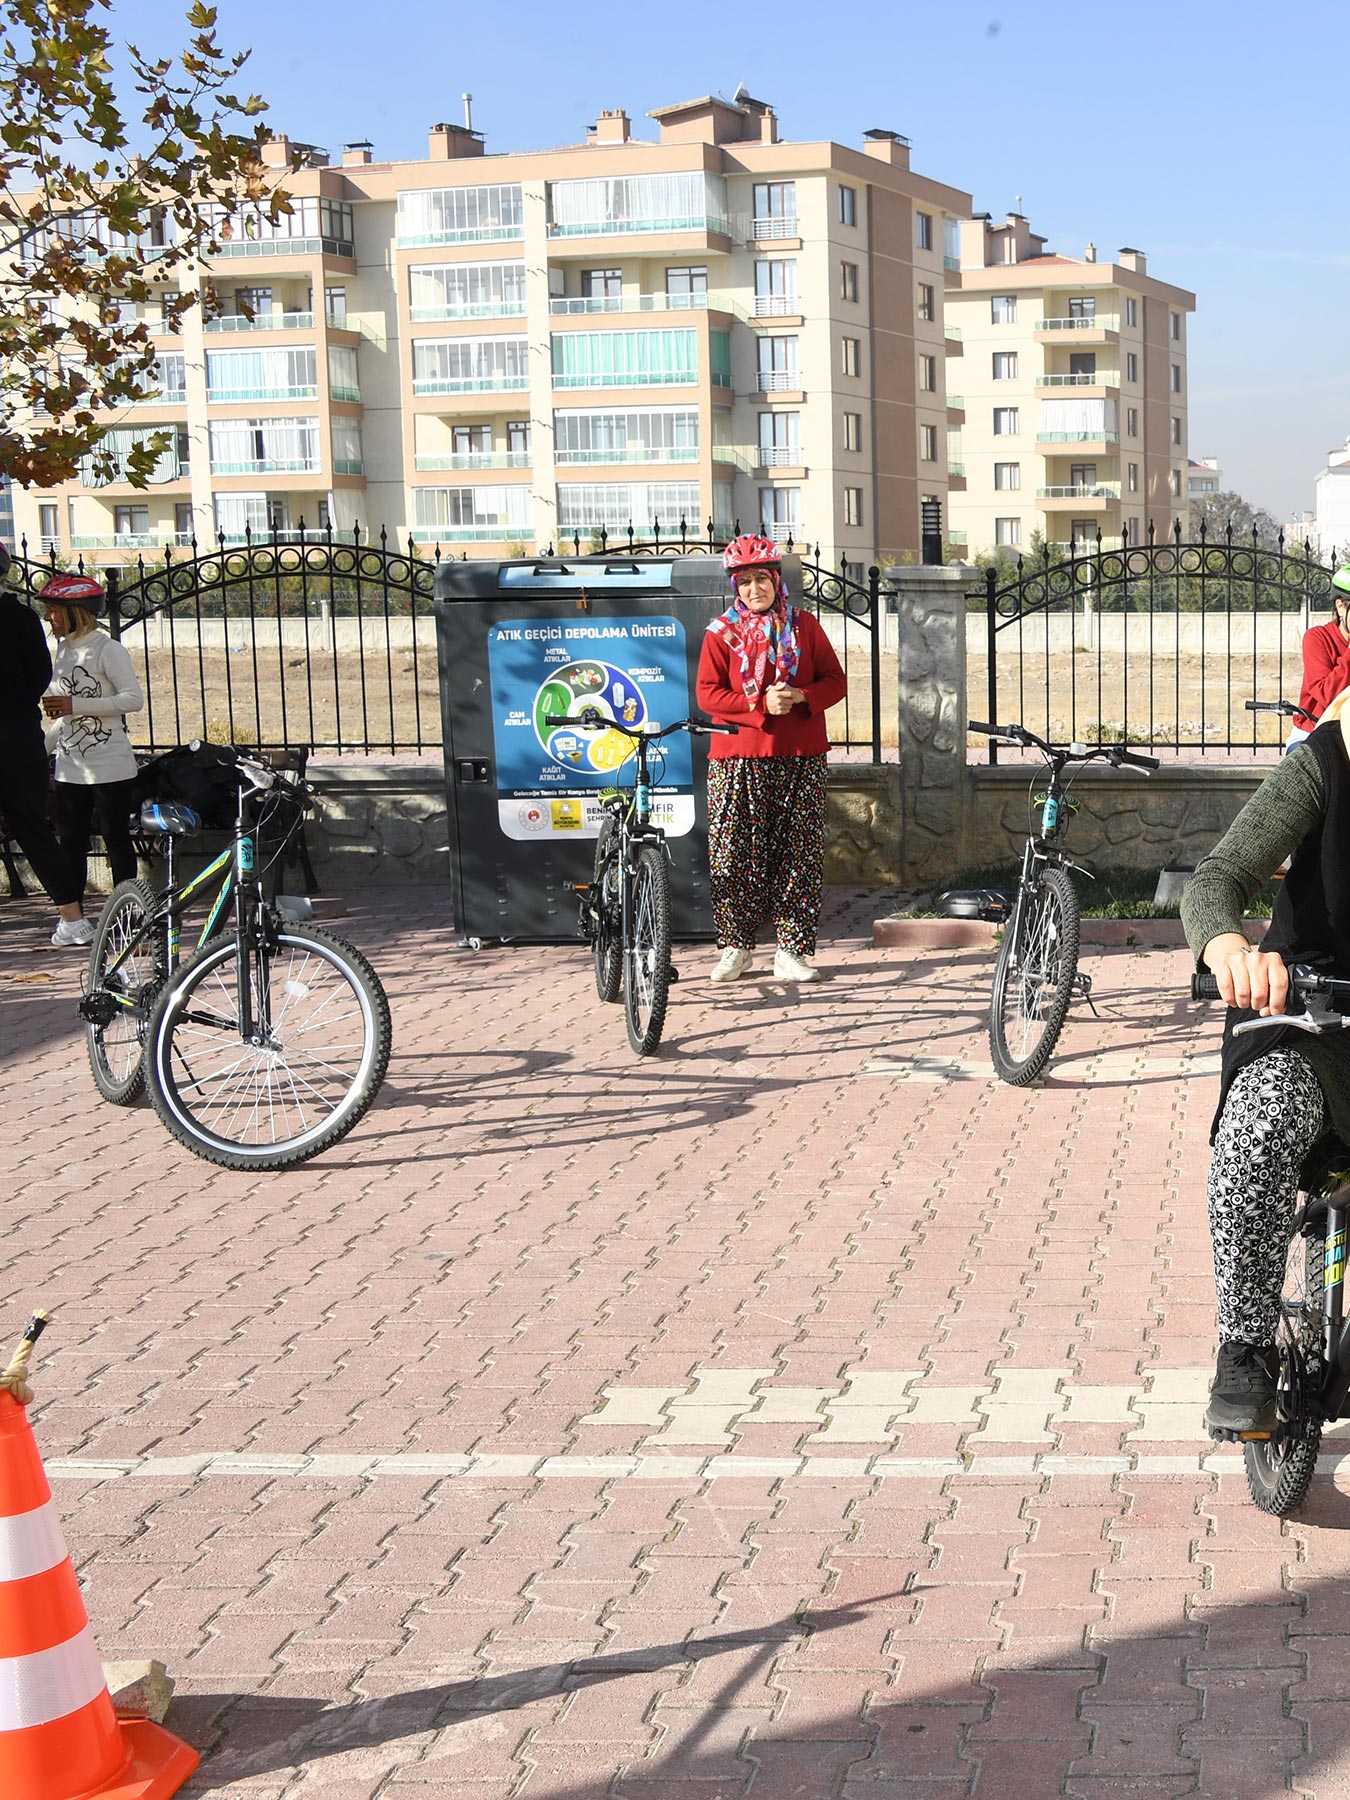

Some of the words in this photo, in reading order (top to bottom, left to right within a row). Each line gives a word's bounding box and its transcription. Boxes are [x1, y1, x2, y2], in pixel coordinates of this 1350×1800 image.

[497, 629, 522, 641] ATIK
[525, 626, 562, 642] GEÇİCİ
[565, 627, 628, 640] DEPOLAMA
[631, 624, 676, 638] ÜNİTESİ
[546, 648, 568, 656] METAL
[544, 655, 571, 663] ATIKLAR
[509, 711, 525, 719] CAM
[504, 718, 532, 726] ATIKLAR
[635, 746, 669, 755] ASTİK
[542, 765, 562, 774] KAĞIT
[539, 773, 566, 781] ATIKLAR
